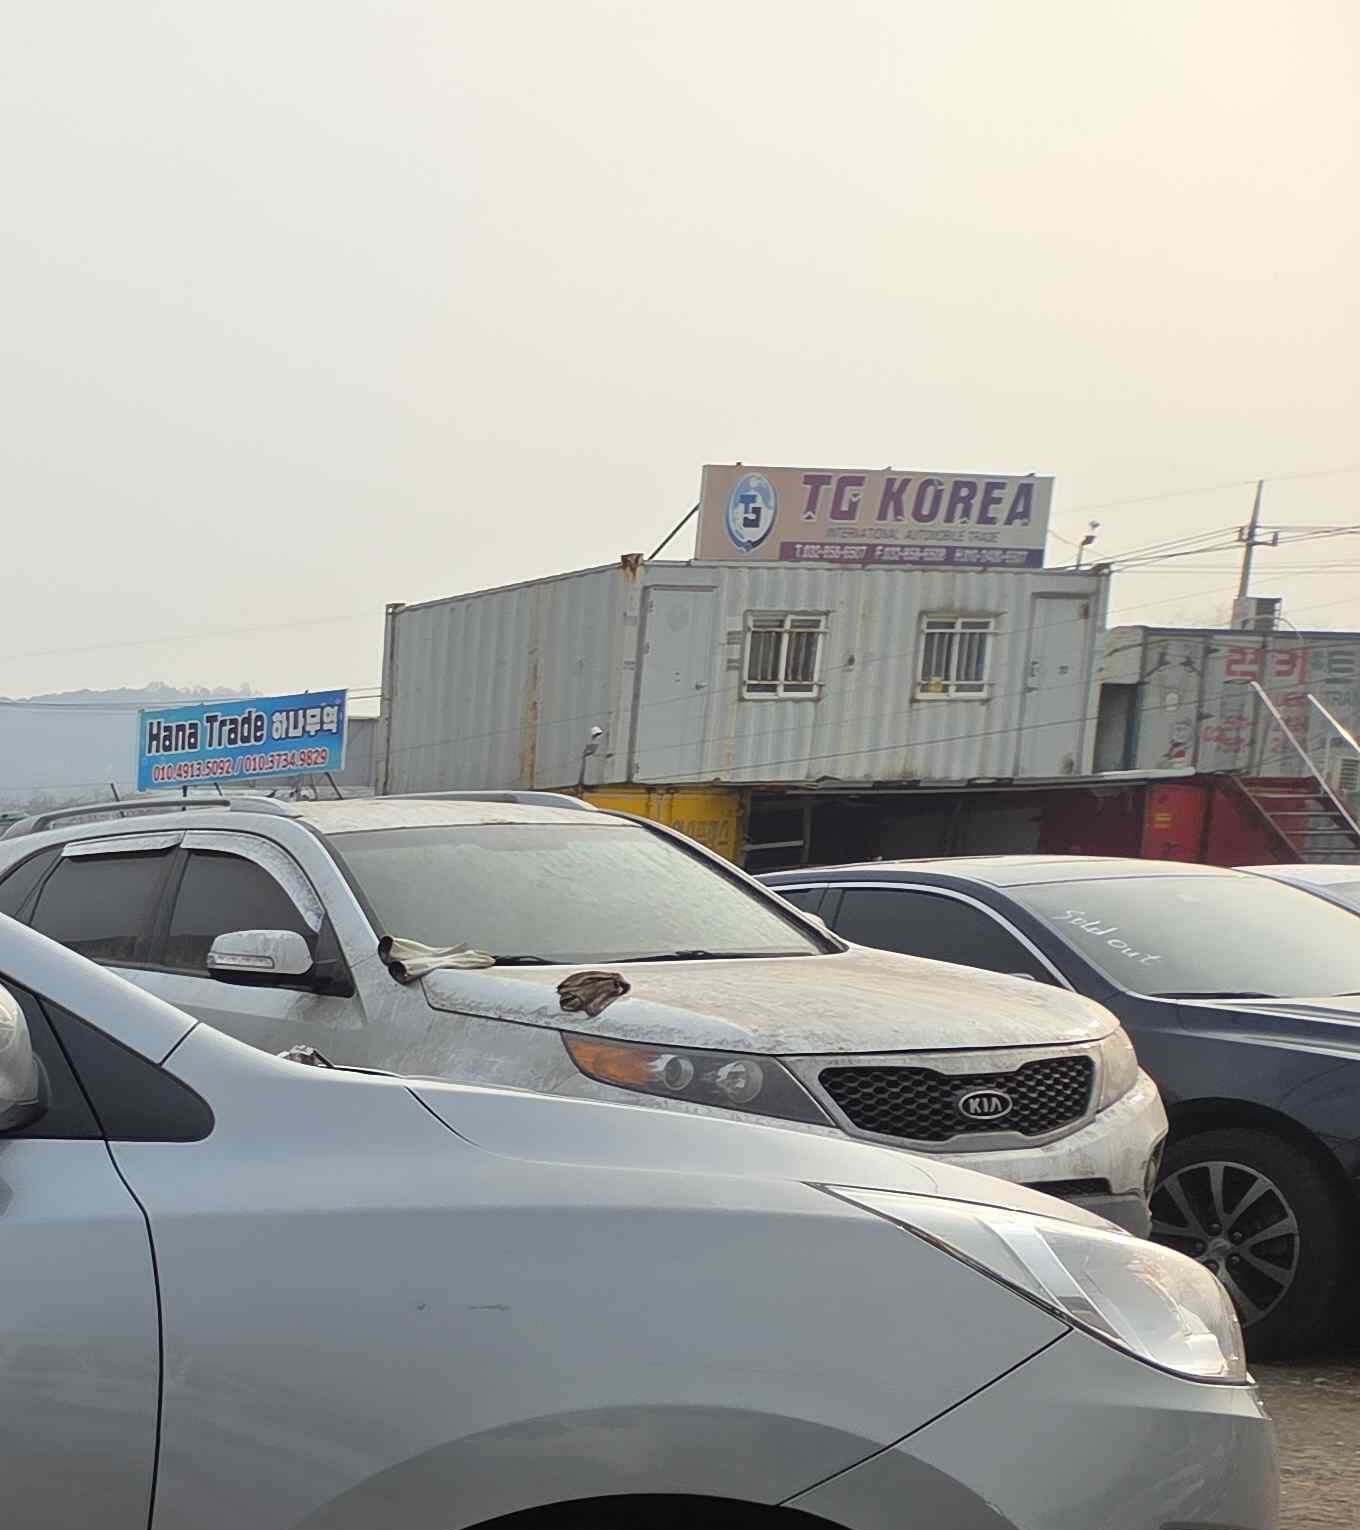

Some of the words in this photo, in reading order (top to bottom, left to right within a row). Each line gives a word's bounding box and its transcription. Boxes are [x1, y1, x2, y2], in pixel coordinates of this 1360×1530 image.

[801, 473, 867, 522] TG
[878, 476, 1036, 527] KOREA
[147, 720, 198, 755] Hana
[205, 710, 265, 748] Trade
[271, 704, 339, 740] 하나무역
[969, 1096, 1003, 1114] KIA
